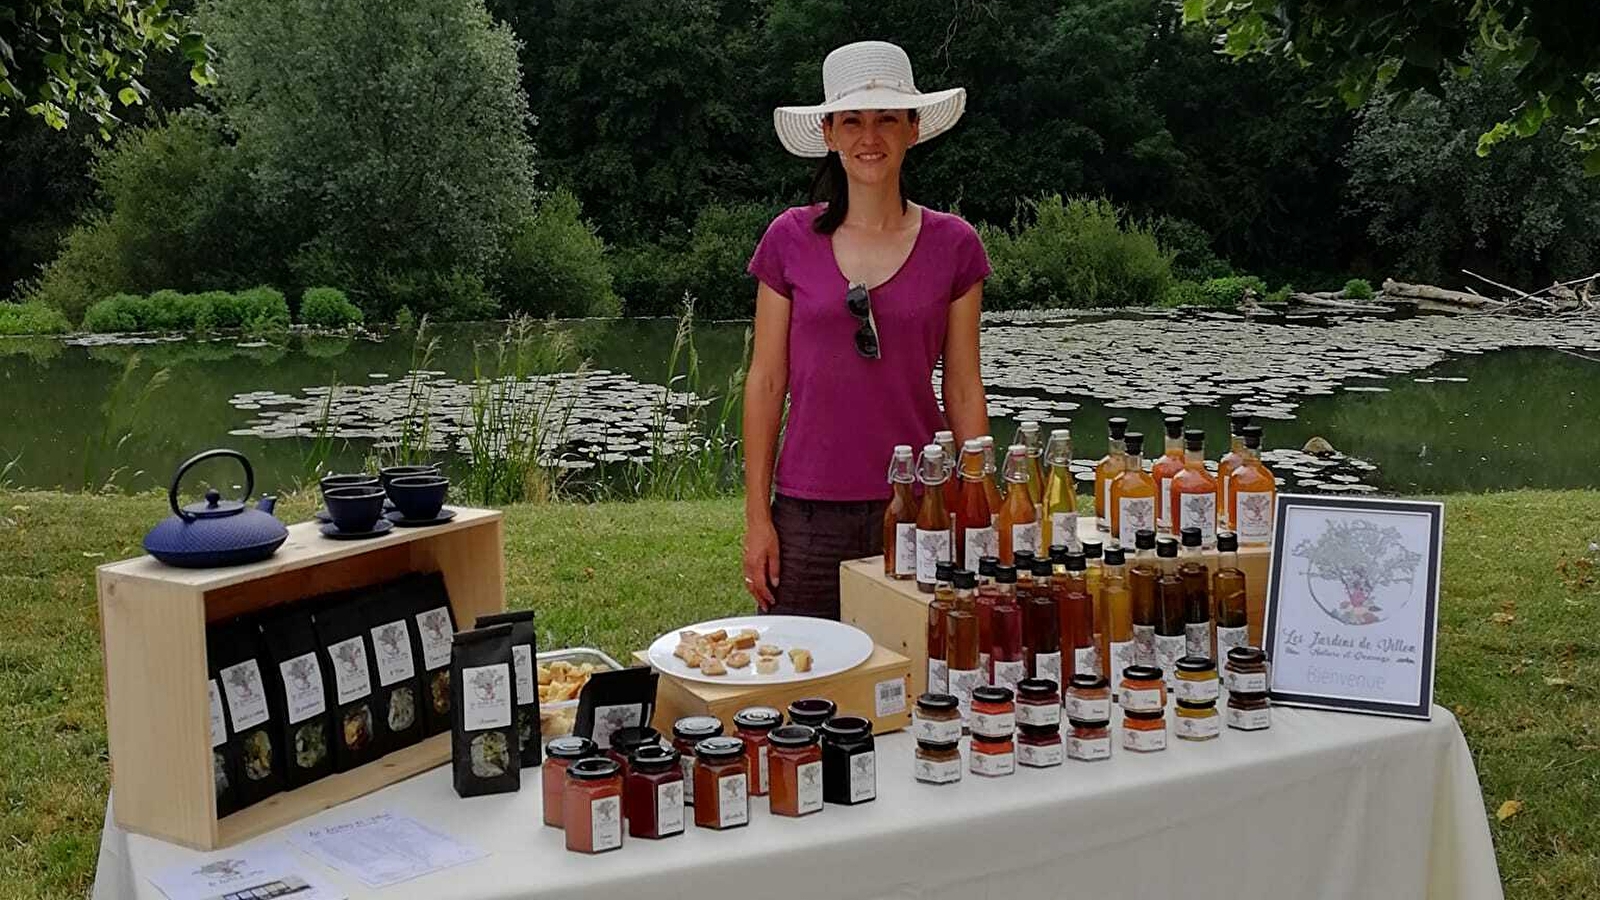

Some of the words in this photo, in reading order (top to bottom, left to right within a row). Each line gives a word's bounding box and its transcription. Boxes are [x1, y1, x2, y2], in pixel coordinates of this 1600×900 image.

[1283, 628, 1302, 646] Les
[1308, 631, 1354, 649] Jardins
[1358, 637, 1371, 650] de
[1307, 665, 1386, 690] Bienvenue
